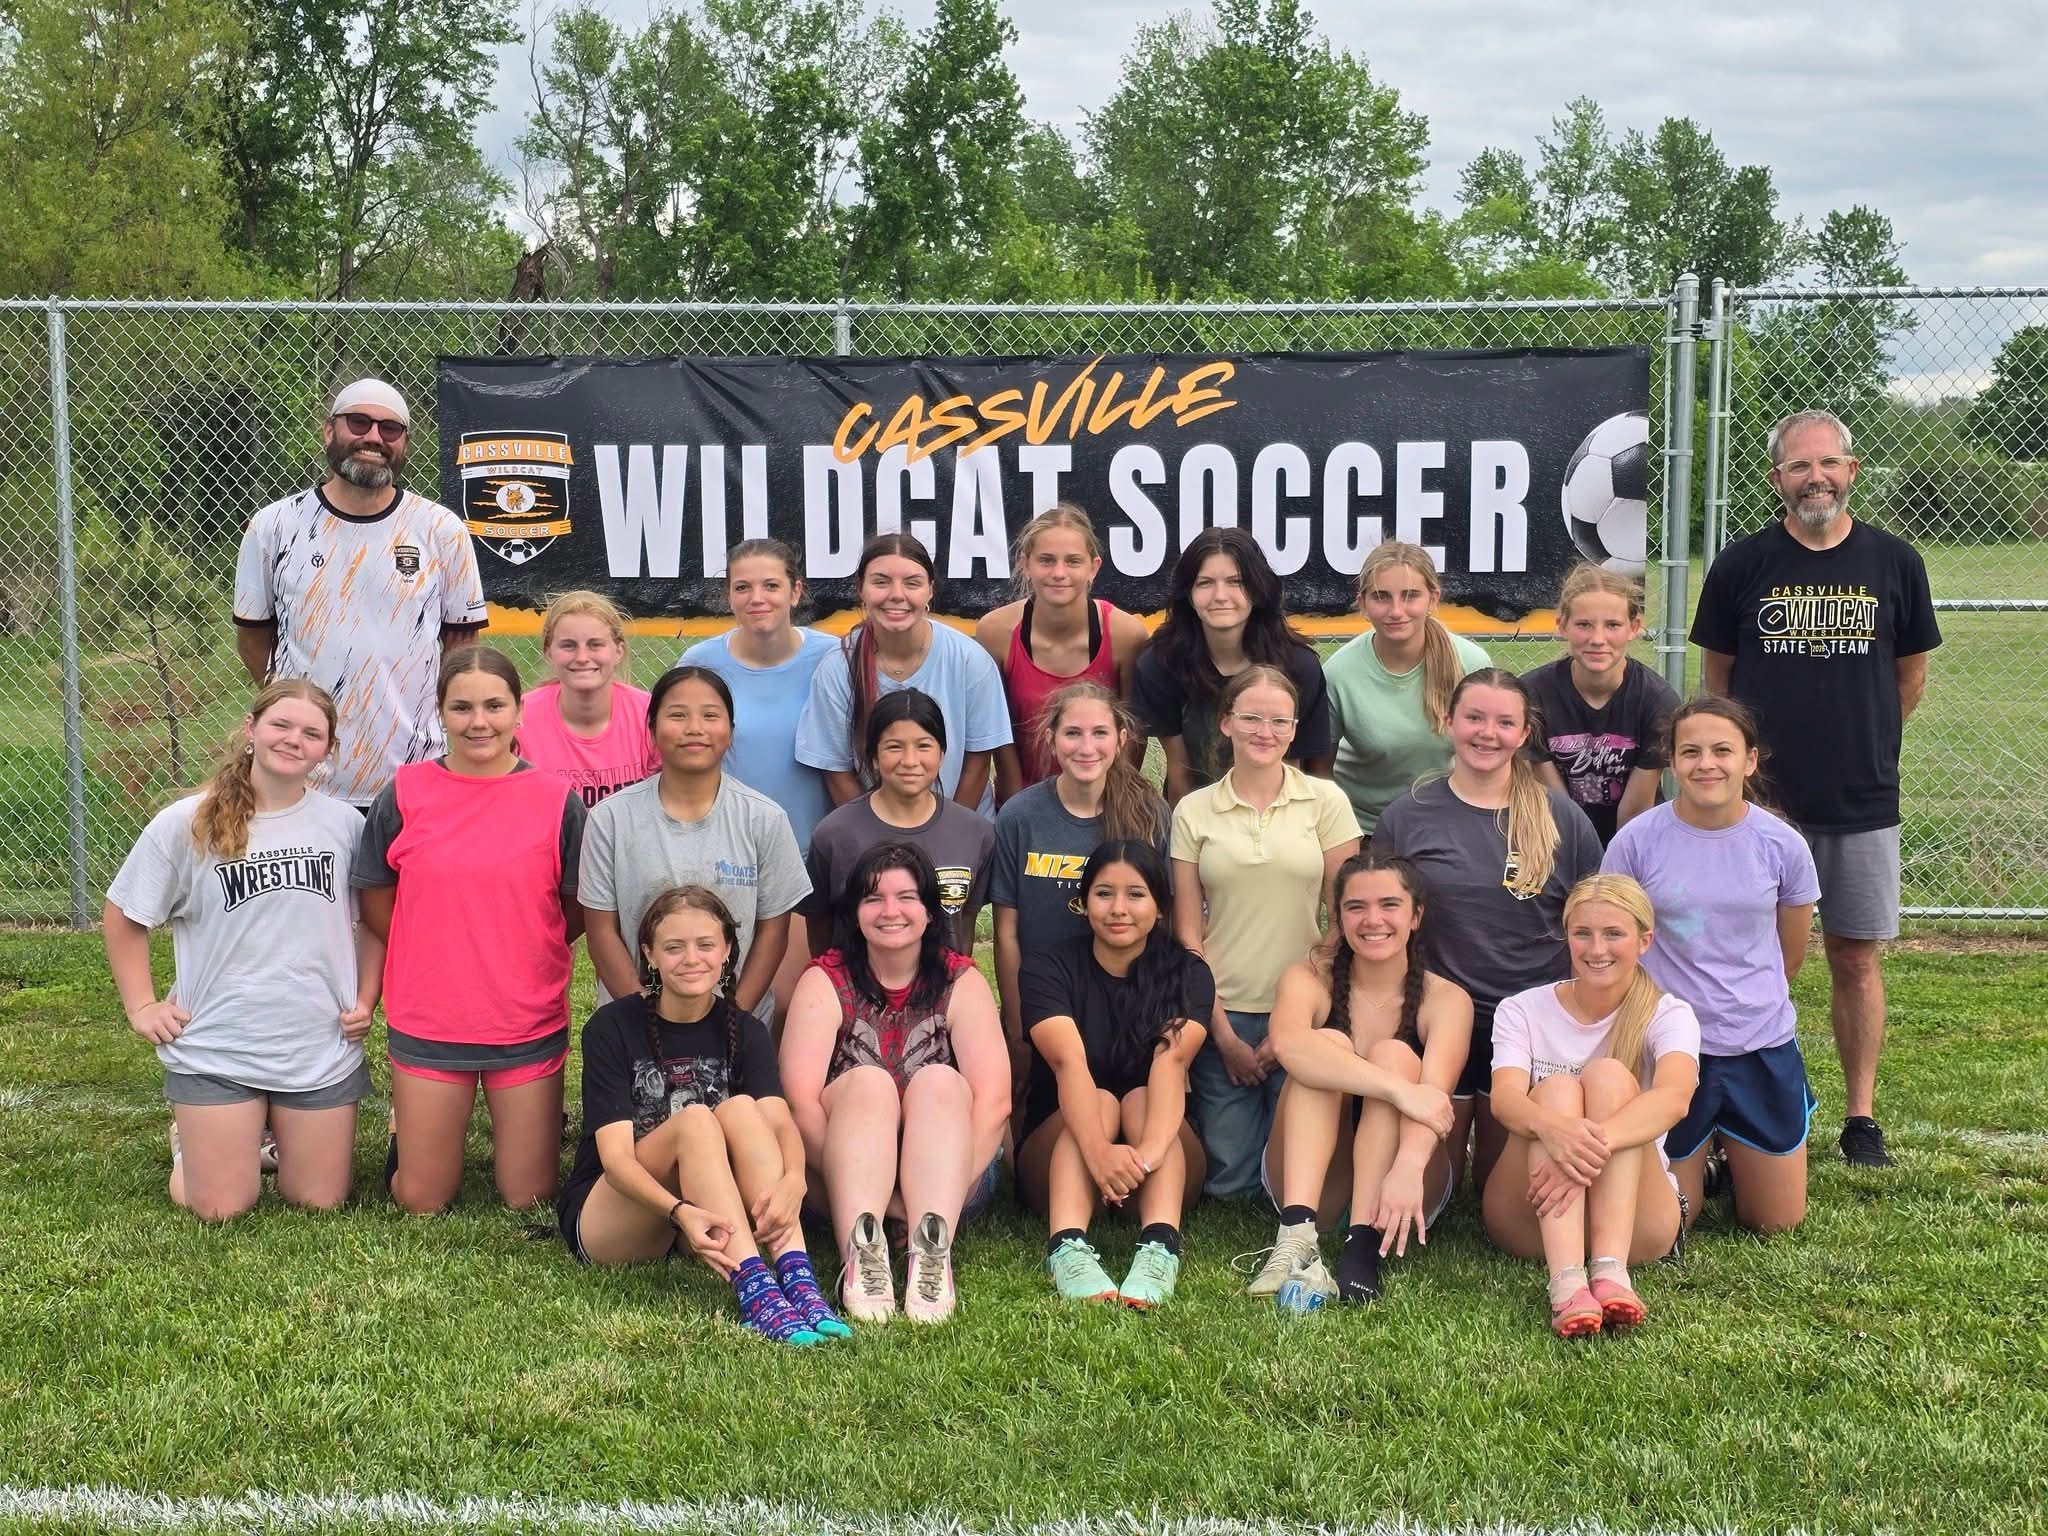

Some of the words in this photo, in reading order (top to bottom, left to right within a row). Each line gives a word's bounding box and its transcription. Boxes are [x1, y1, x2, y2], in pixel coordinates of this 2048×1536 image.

[832, 354, 1239, 465] CASSVILLE
[462, 442, 567, 460] CASSVILLE
[486, 466, 543, 475] WILDCAT
[1108, 440, 1530, 577] SOCCER
[485, 526, 549, 536] SOCCER
[1772, 585, 1867, 597] CASSVILLE
[1785, 598, 1879, 631] WILDCAT
[1763, 640, 1807, 654] STATE
[1830, 640, 1870, 655] TEAM
[250, 846, 314, 860] CASSVILLE
[1024, 852, 1090, 879] MIZ
[216, 853, 335, 911] WRESTLING
